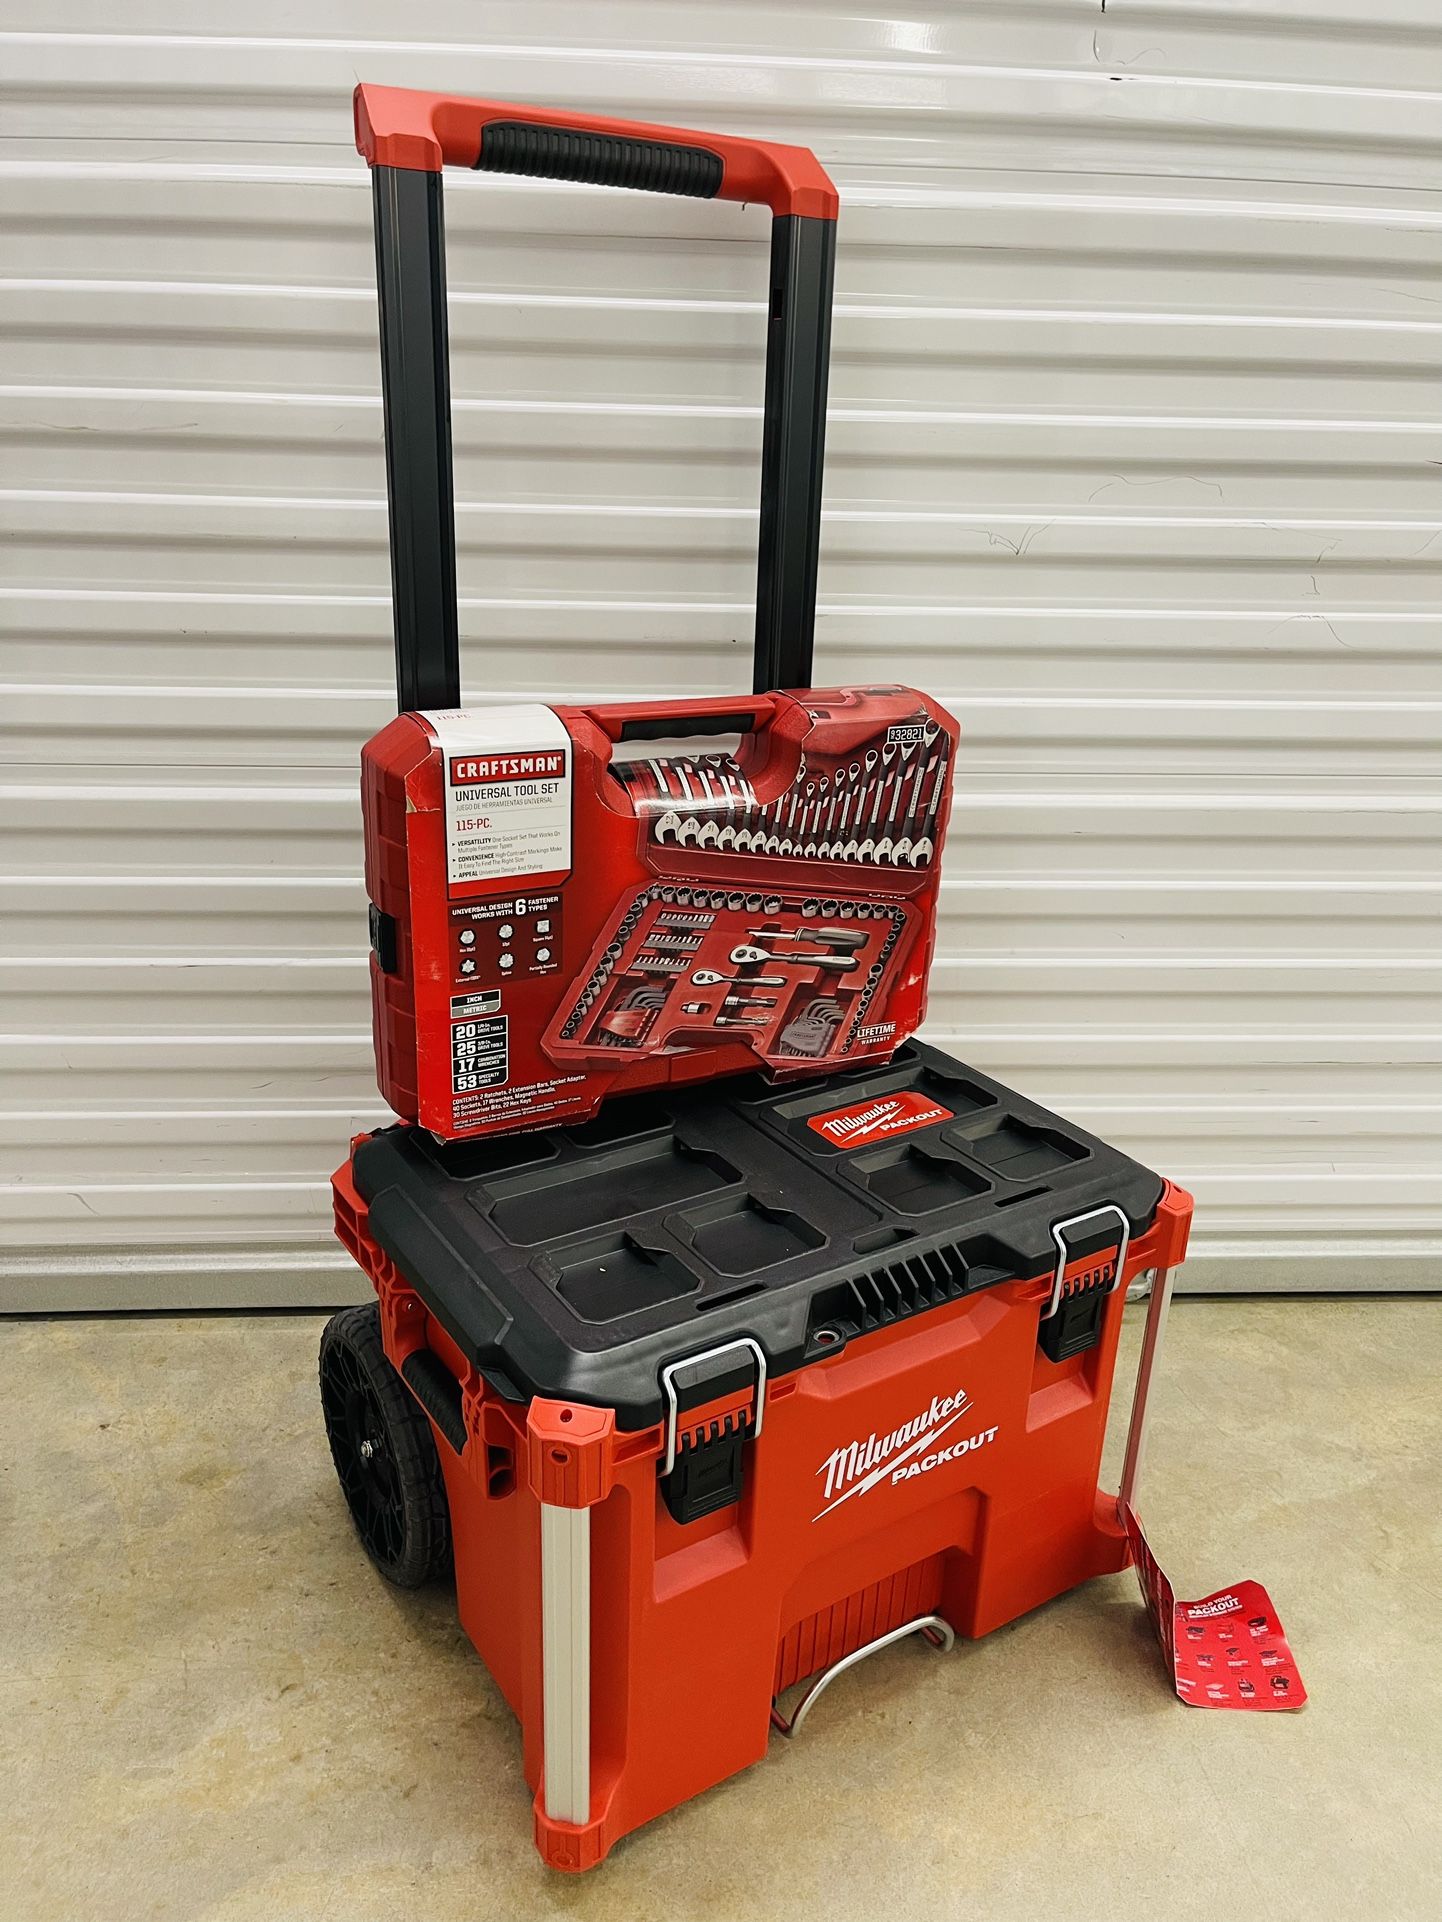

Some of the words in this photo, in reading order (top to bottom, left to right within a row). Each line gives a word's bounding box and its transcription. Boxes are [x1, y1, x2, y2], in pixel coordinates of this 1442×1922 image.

[456, 787, 512, 802] UNIVERSAL
[514, 784, 538, 796] TOOL
[541, 782, 559, 794] SET
[456, 804, 472, 812] JUEGO
[482, 800, 523, 809] HERRAMIENTAS
[524, 797, 552, 806] UNIVERSAL
[456, 818, 492, 831] 115-PC.
[458, 838, 492, 847] VERSATILITY
[502, 834, 519, 842] Socket
[458, 853, 495, 863] CONVENIENCE
[458, 870, 478, 879] APPEAL
[452, 905, 488, 916] UNIVERSAL
[489, 902, 513, 911] DESIGN
[515, 899, 526, 915] 6
[528, 896, 559, 905] FASTENER
[471, 911, 495, 920] WORKS
[528, 904, 548, 912] TYPES
[467, 995, 482, 1003] INCH
[463, 1005, 487, 1014] METRIC
[456, 1024, 476, 1040] 20
[857, 1023, 896, 1037] LIFETIME
[457, 1040, 476, 1056] 25
[861, 1036, 890, 1045] WARRANTY
[458, 1058, 475, 1073] 17
[457, 1074, 477, 1090] 53
[479, 1072, 499, 1080] SPECIALTY
[550, 1078, 566, 1086] Socket
[822, 1100, 900, 1137] Milwaukee
[879, 1108, 943, 1131] PACKOUT
[816, 1389, 967, 1498] Milwaukee
[892, 1426, 999, 1485] PACKOUT
[1214, 1594, 1232, 1604] YOUR
[1187, 1598, 1239, 1616] PACKOUT
